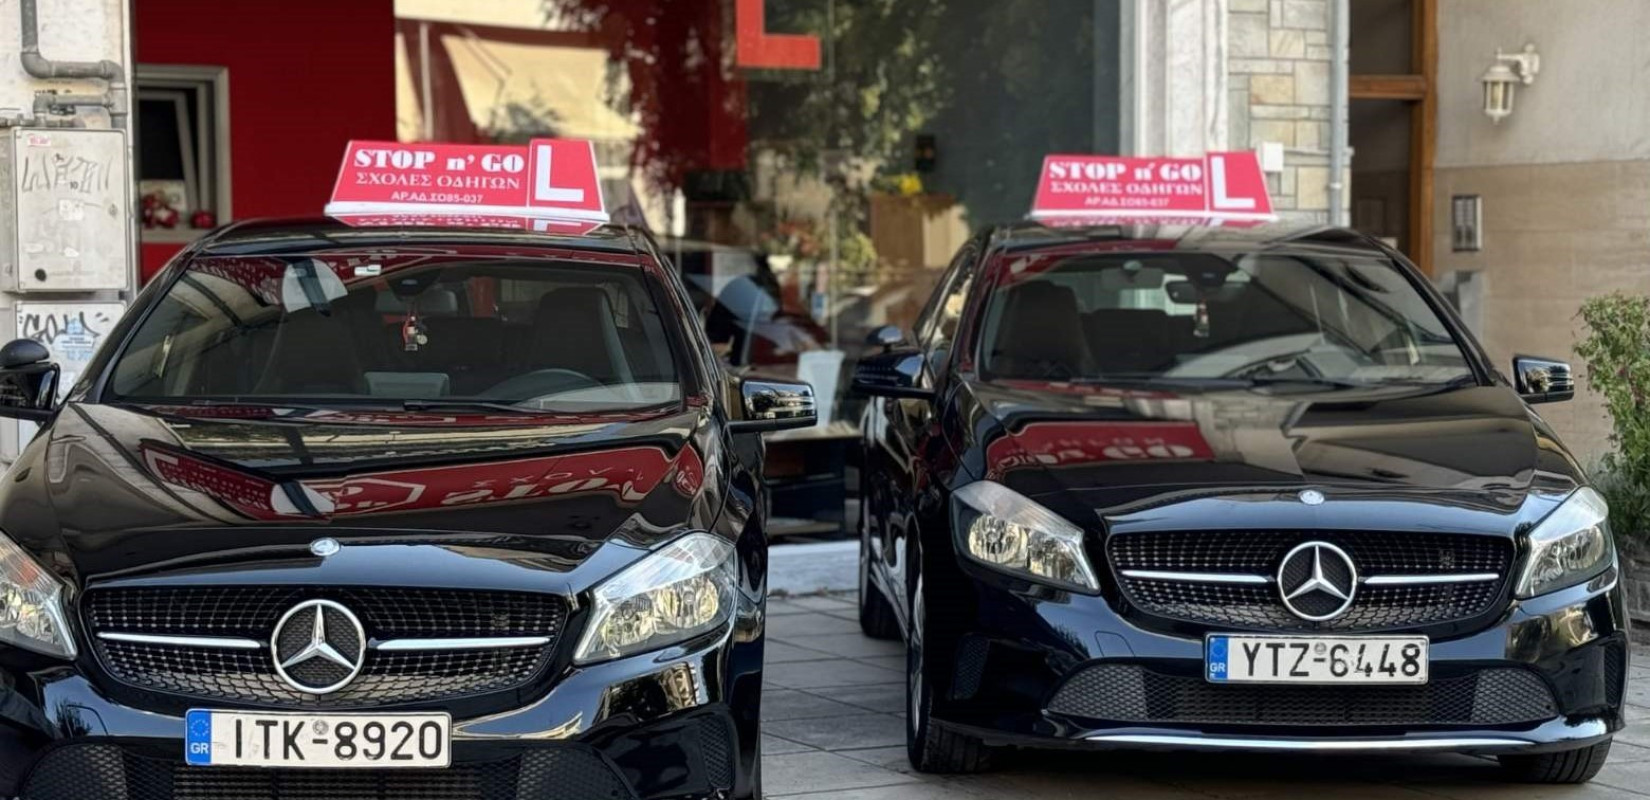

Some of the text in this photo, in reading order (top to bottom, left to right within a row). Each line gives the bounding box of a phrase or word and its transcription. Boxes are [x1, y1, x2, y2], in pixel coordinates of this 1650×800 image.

[354, 149, 436, 169] STOP
[481, 153, 525, 173] GO
[1049, 161, 1126, 180] STOP
[1160, 163, 1202, 182] GO
[355, 172, 520, 190] ΣΧΟΛΕΣ ΟΔΗΓΩΝ
[535, 145, 585, 202] L
[1210, 156, 1256, 209] L
[1209, 663, 1227, 673] GR
[190, 742, 209, 755] GR
[235, 718, 443, 761] ITK-8920
